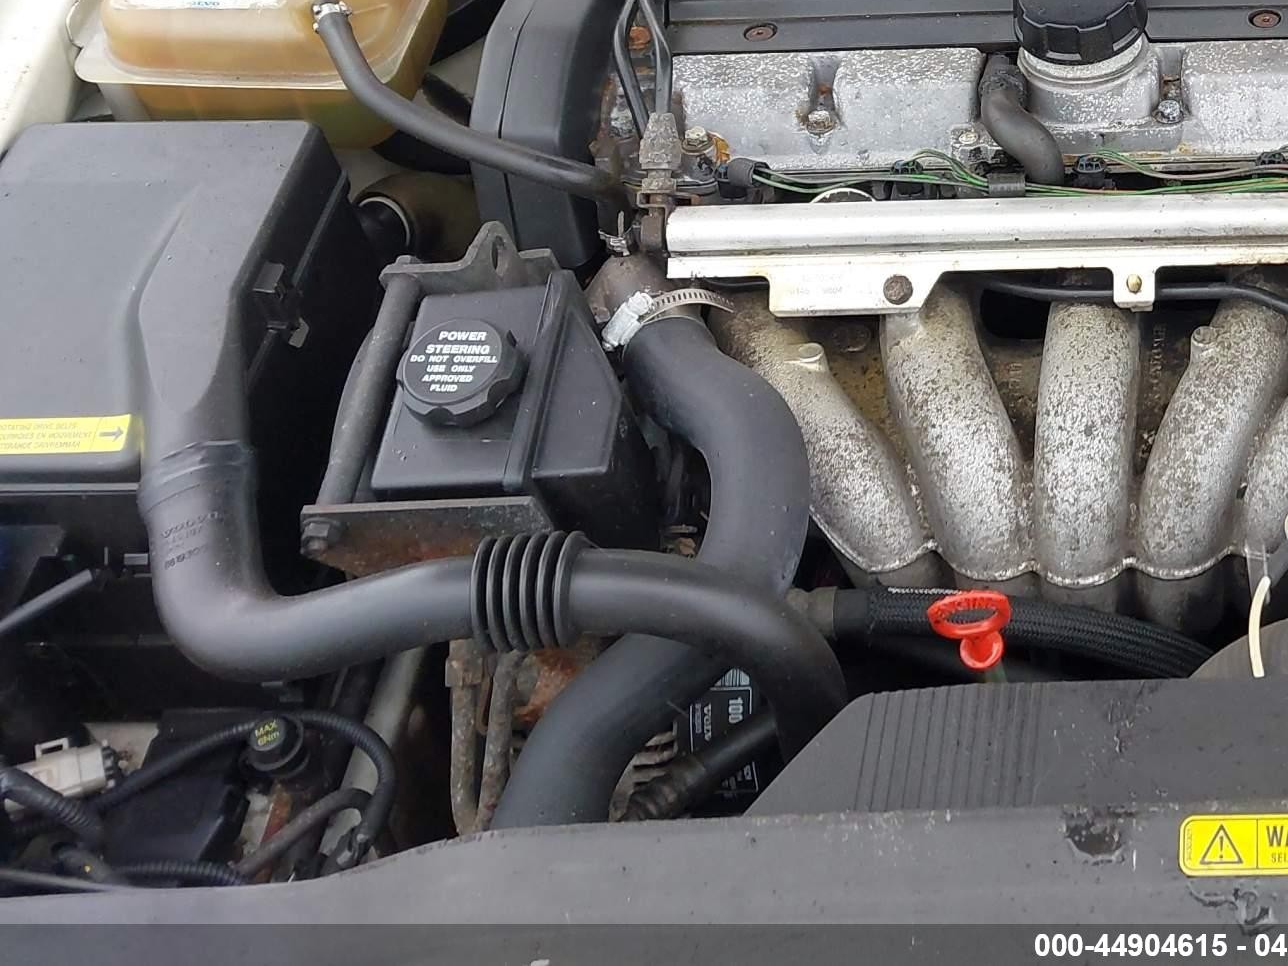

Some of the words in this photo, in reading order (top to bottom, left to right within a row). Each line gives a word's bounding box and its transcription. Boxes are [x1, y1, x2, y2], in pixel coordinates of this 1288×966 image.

[438, 331, 487, 341] POWER
[425, 344, 490, 355] STEERING
[410, 355, 425, 363] DO
[428, 355, 449, 363] NOT
[453, 355, 498, 364] OVERFILL
[451, 365, 476, 373] ONLY
[421, 374, 473, 382] APPROVED
[429, 384, 458, 392] FLUID
[703, 703, 712, 742] VOLV
